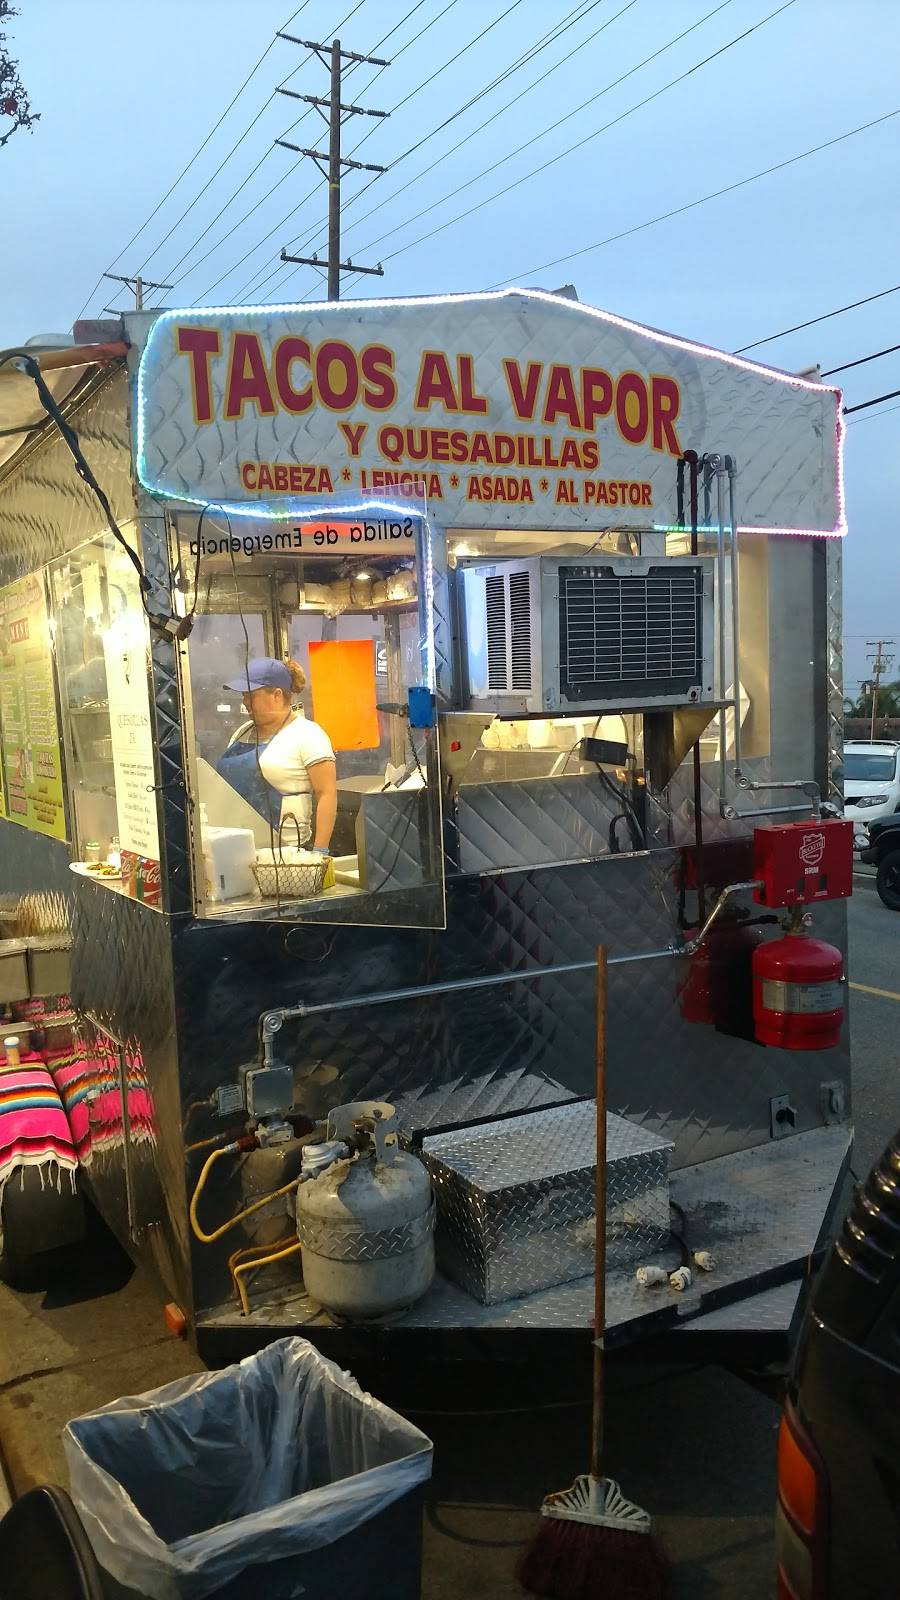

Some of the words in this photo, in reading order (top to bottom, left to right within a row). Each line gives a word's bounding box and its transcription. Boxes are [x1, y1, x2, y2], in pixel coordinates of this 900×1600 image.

[177, 327, 398, 425] TACOS
[414, 350, 489, 416] AL
[502, 357, 684, 459] VAPOR
[338, 421, 369, 457] Y
[376, 424, 600, 471] QUESADILLAS
[240, 462, 334, 493] CABEZA
[359, 469, 444, 500] LENGUA
[466, 474, 535, 502] ASADA
[555, 479, 580, 504] AL
[583, 480, 653, 506] PASTOR
